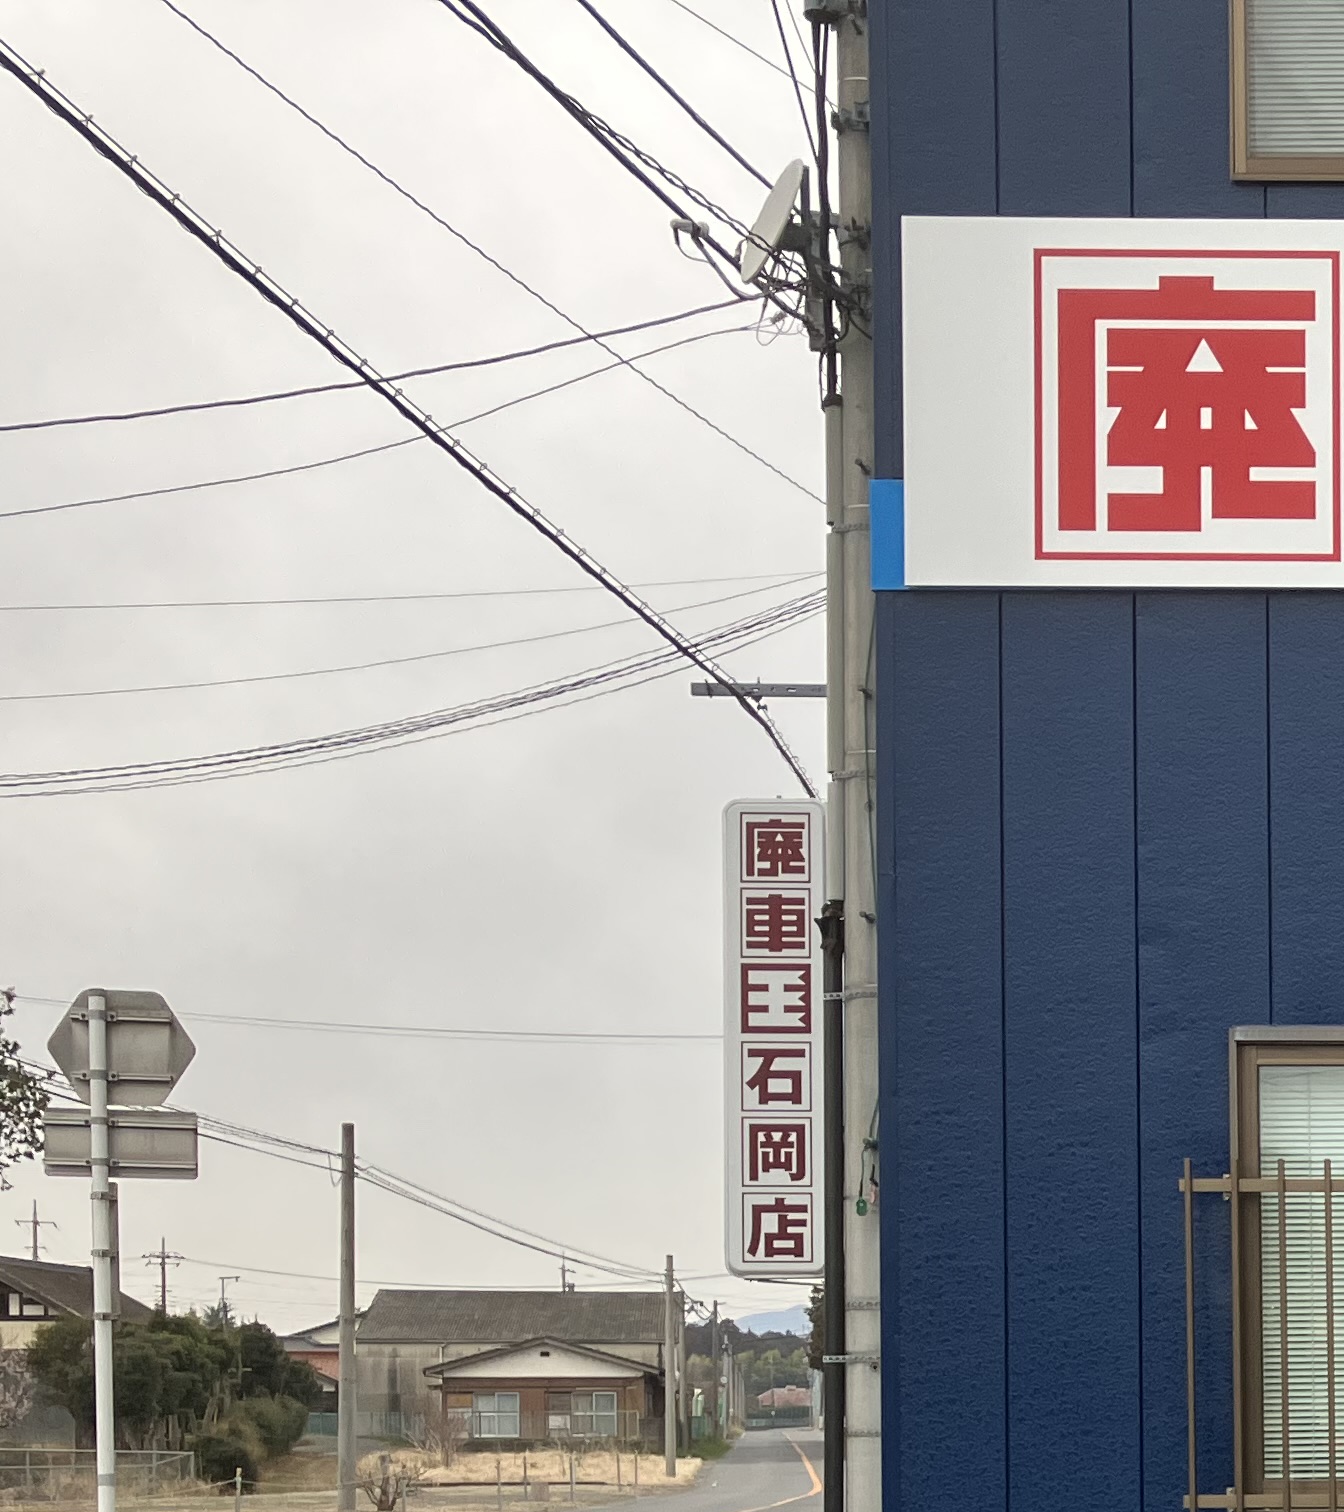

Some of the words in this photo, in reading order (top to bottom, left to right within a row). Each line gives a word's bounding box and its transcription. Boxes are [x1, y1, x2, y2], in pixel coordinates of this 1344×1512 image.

[741, 817, 811, 1260] 廃車王石岡店
